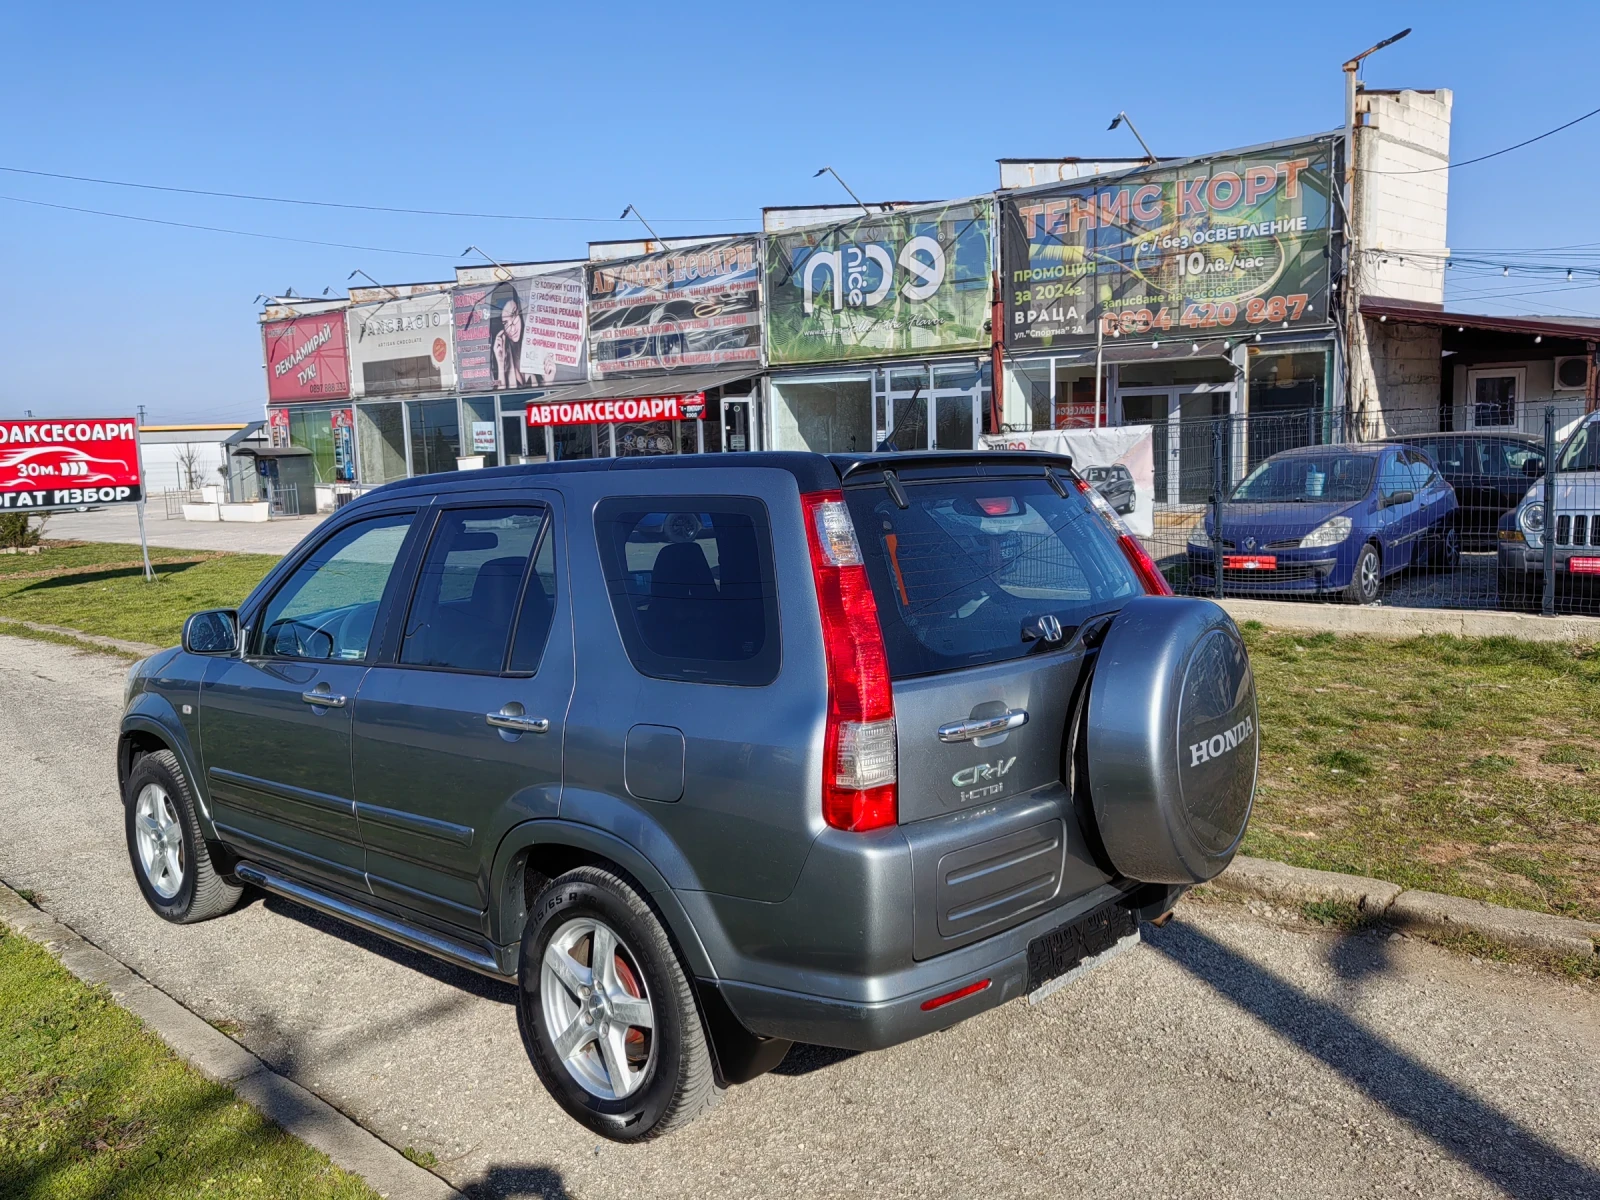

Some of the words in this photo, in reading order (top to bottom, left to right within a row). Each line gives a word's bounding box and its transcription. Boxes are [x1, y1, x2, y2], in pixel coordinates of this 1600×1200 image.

[1019, 184, 1164, 240] ТЕНИС
[1174, 158, 1310, 217] КОРТ
[1162, 235, 1189, 249] без
[1192, 216, 1308, 245] ОСВЕТЛЕНИЕ
[592, 246, 753, 294] АВТОАКСЕСОАРИ
[1013, 261, 1097, 283] ПРОМОЦИЯ
[1014, 290, 1032, 306] за
[1168, 292, 1183, 301] на
[1186, 286, 1235, 300] часове:
[907, 313, 946, 331] Flavor
[1014, 306, 1085, 325] ВРАЦА,
[1102, 306, 1173, 336] 0894
[1179, 301, 1238, 328] 420
[1246, 293, 1309, 324] 887
[275, 323, 332, 378] РЕКЛАМИРАЙ
[297, 363, 316, 386] ТУК!
[531, 397, 677, 424] АВТОАКСЕСОАРИ
[17, 463, 58, 476] 30м.
[0, 491, 46, 507] ГАТ
[54, 486, 130, 504] ИЗБОР
[1189, 715, 1254, 767] HONDA
[952, 756, 1017, 787] CR-V
